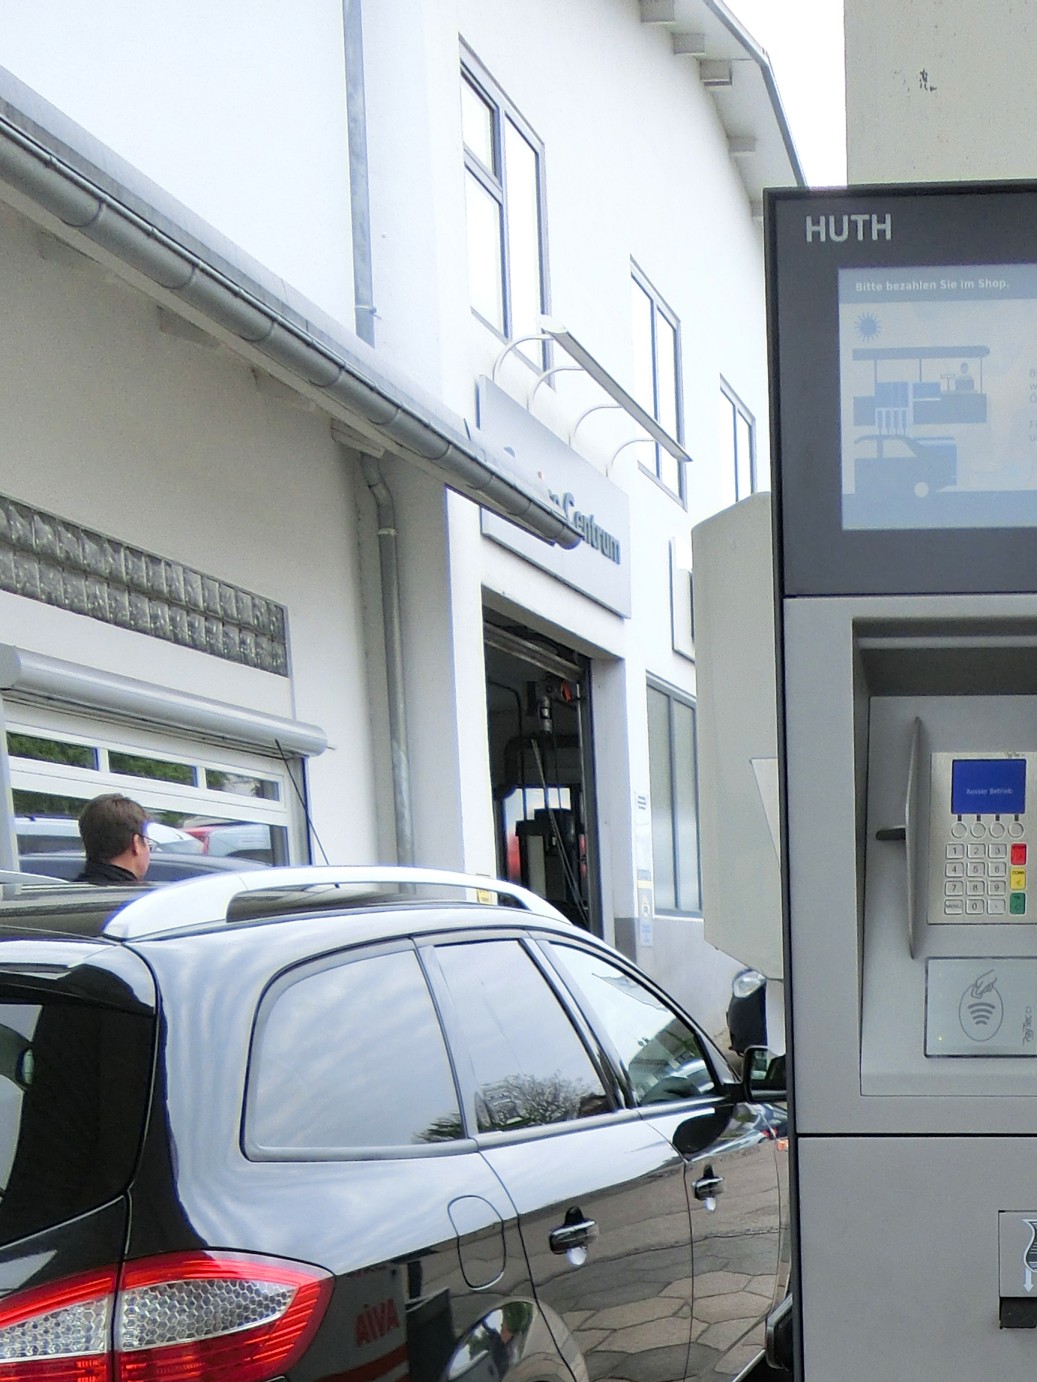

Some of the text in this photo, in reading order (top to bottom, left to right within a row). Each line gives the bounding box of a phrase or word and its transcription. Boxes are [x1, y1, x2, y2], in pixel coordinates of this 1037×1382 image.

[805, 213, 892, 242] HUTH
[855, 278, 1010, 292] Bitte bezahlen Sie im Shop.
[973, 847, 979, 855] 2
[994, 884, 1000, 892] 9
